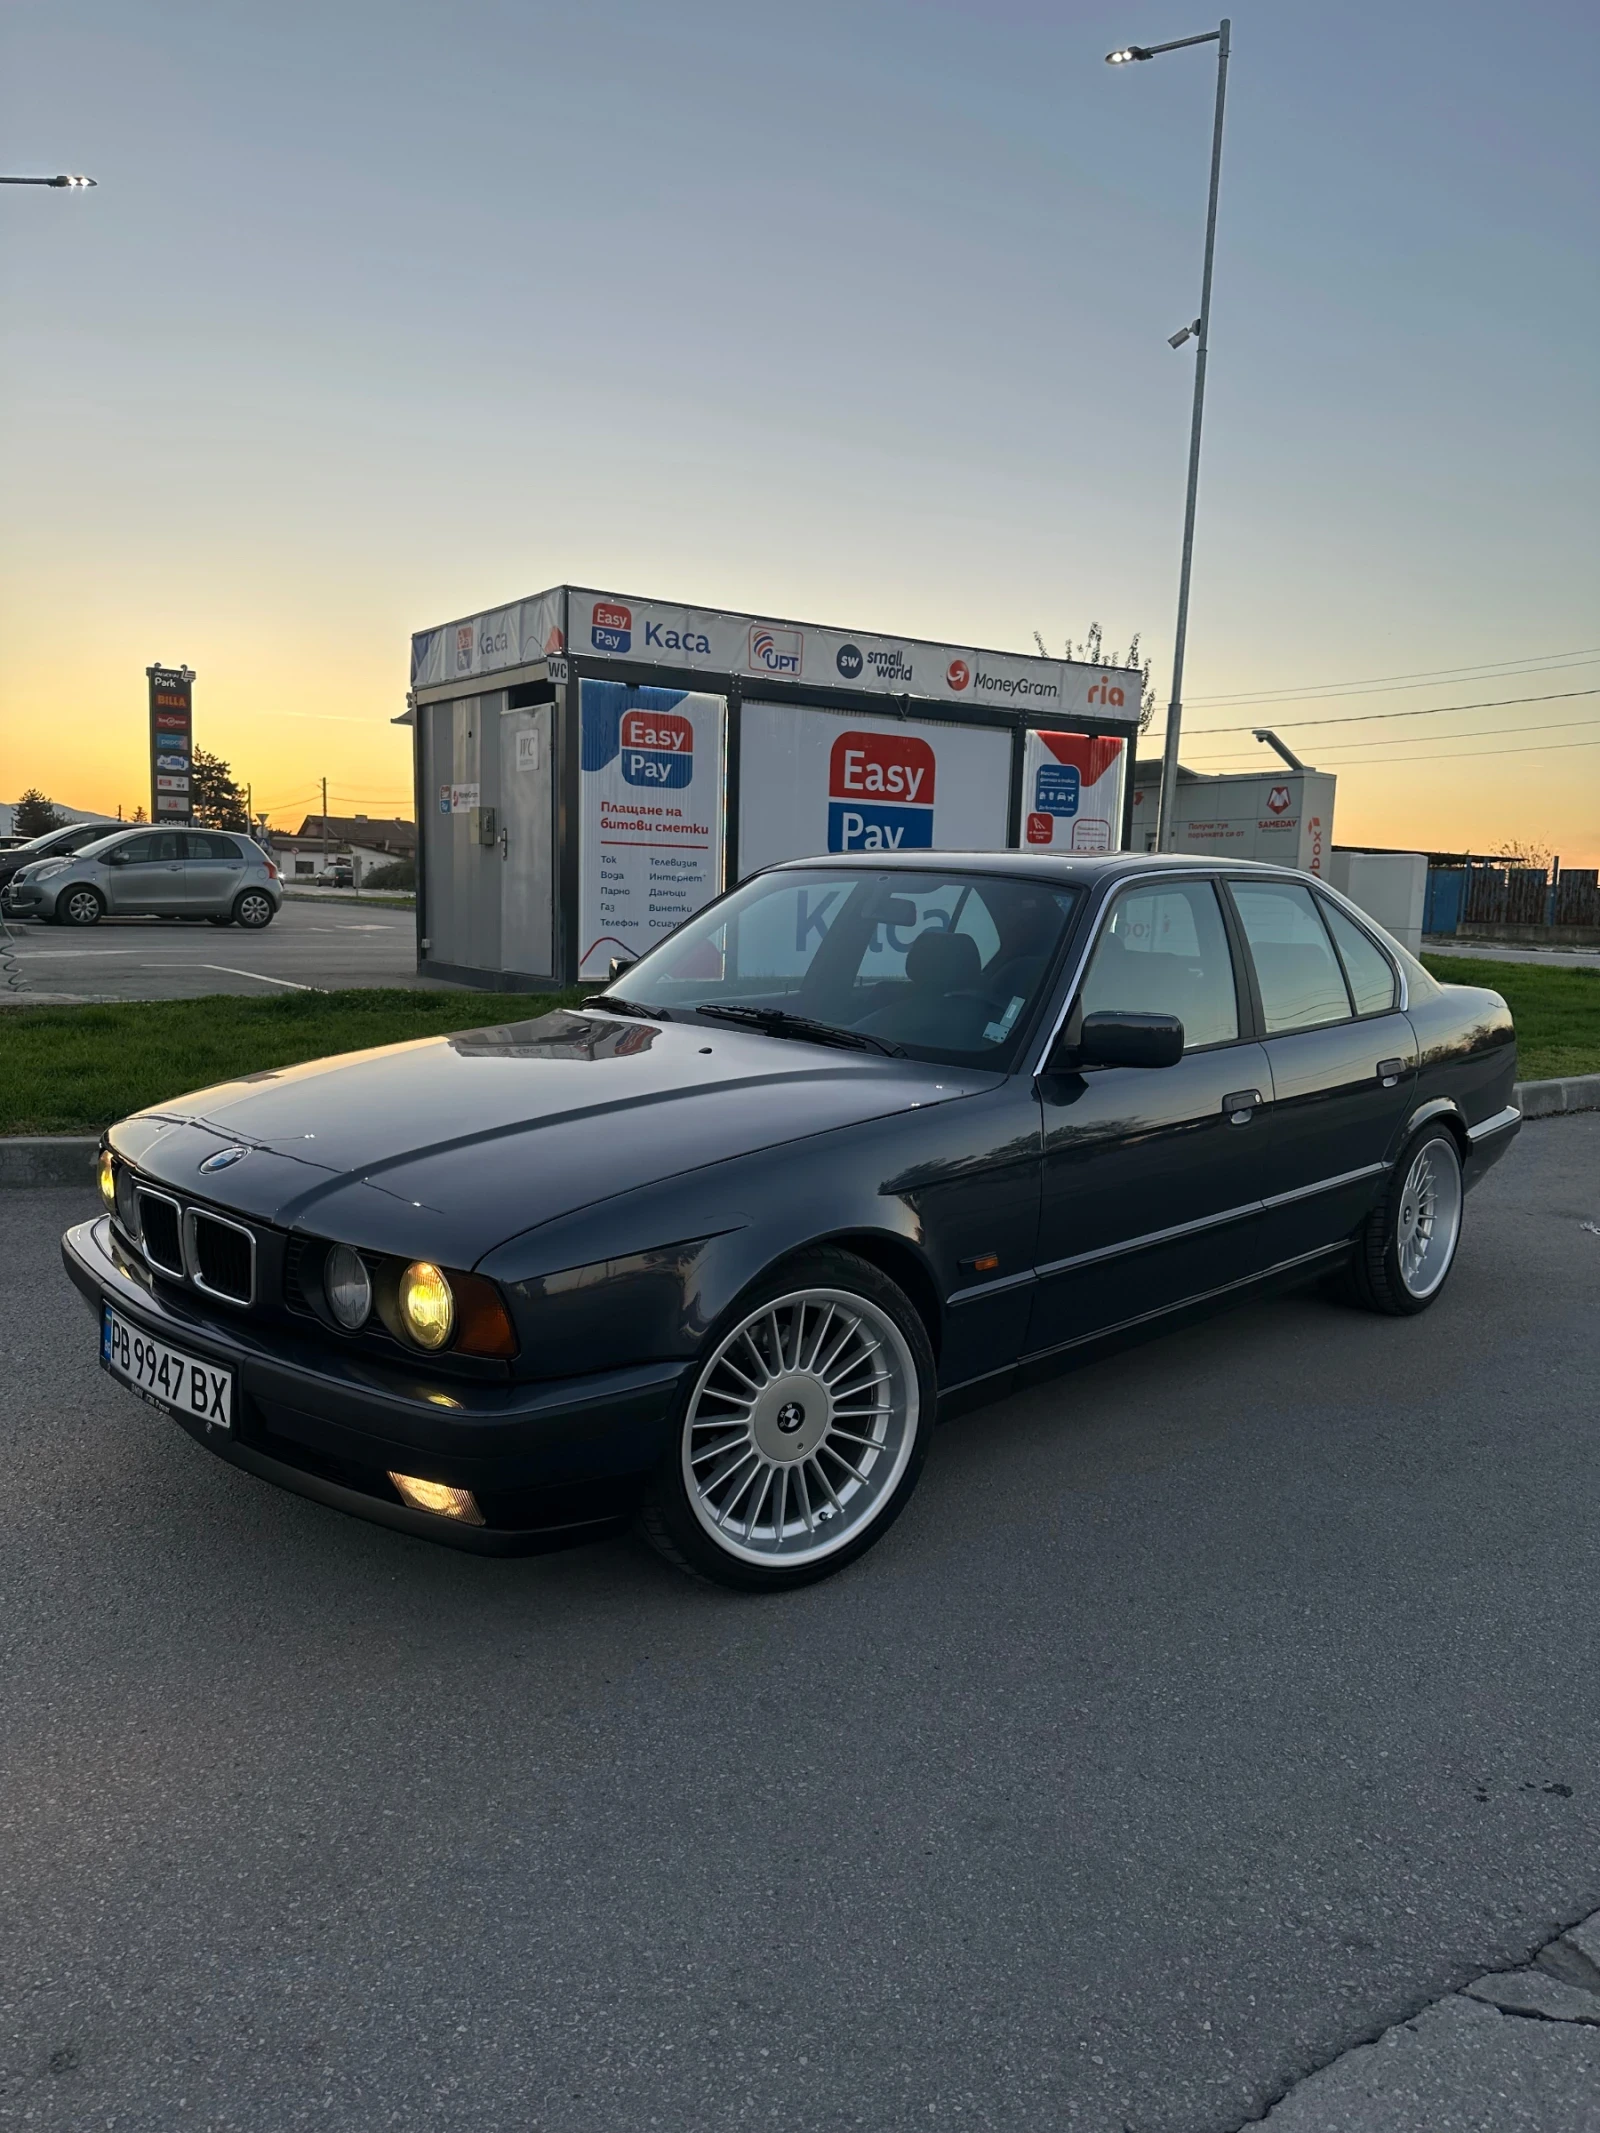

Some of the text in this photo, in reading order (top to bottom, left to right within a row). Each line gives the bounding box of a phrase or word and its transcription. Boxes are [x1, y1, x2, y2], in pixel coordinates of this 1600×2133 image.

[597, 608, 627, 629] Easy
[476, 632, 508, 656] Каса
[596, 631, 622, 649] Pay
[645, 621, 711, 654] Каса
[766, 652, 800, 672] UPT
[867, 650, 903, 667] small
[549, 660, 567, 680] WC
[876, 660, 913, 682] world
[154, 677, 177, 688] Park
[974, 672, 1058, 698] MoneyGram
[1087, 676, 1125, 707] ria
[157, 694, 186, 706] BILLA
[630, 721, 685, 749] Easy
[519, 737, 535, 757] WC
[630, 755, 672, 782] Pay
[843, 750, 925, 801] Easy
[601, 801, 683, 817] Плащане на
[600, 817, 709, 834] битови сметки
[1258, 819, 1297, 829] SAMEDAY
[601, 855, 617, 864] Ток
[650, 857, 698, 868] Телевизия
[600, 870, 624, 880] Вода
[600, 886, 630, 897] Парно
[649, 888, 686, 898] Данъци
[600, 902, 615, 912] Газ
[648, 904, 693, 913] Винетки
[600, 918, 639, 928] Телефон
[795, 890, 952, 954] Кса
[112, 1318, 228, 1423] PB 9947 BX
